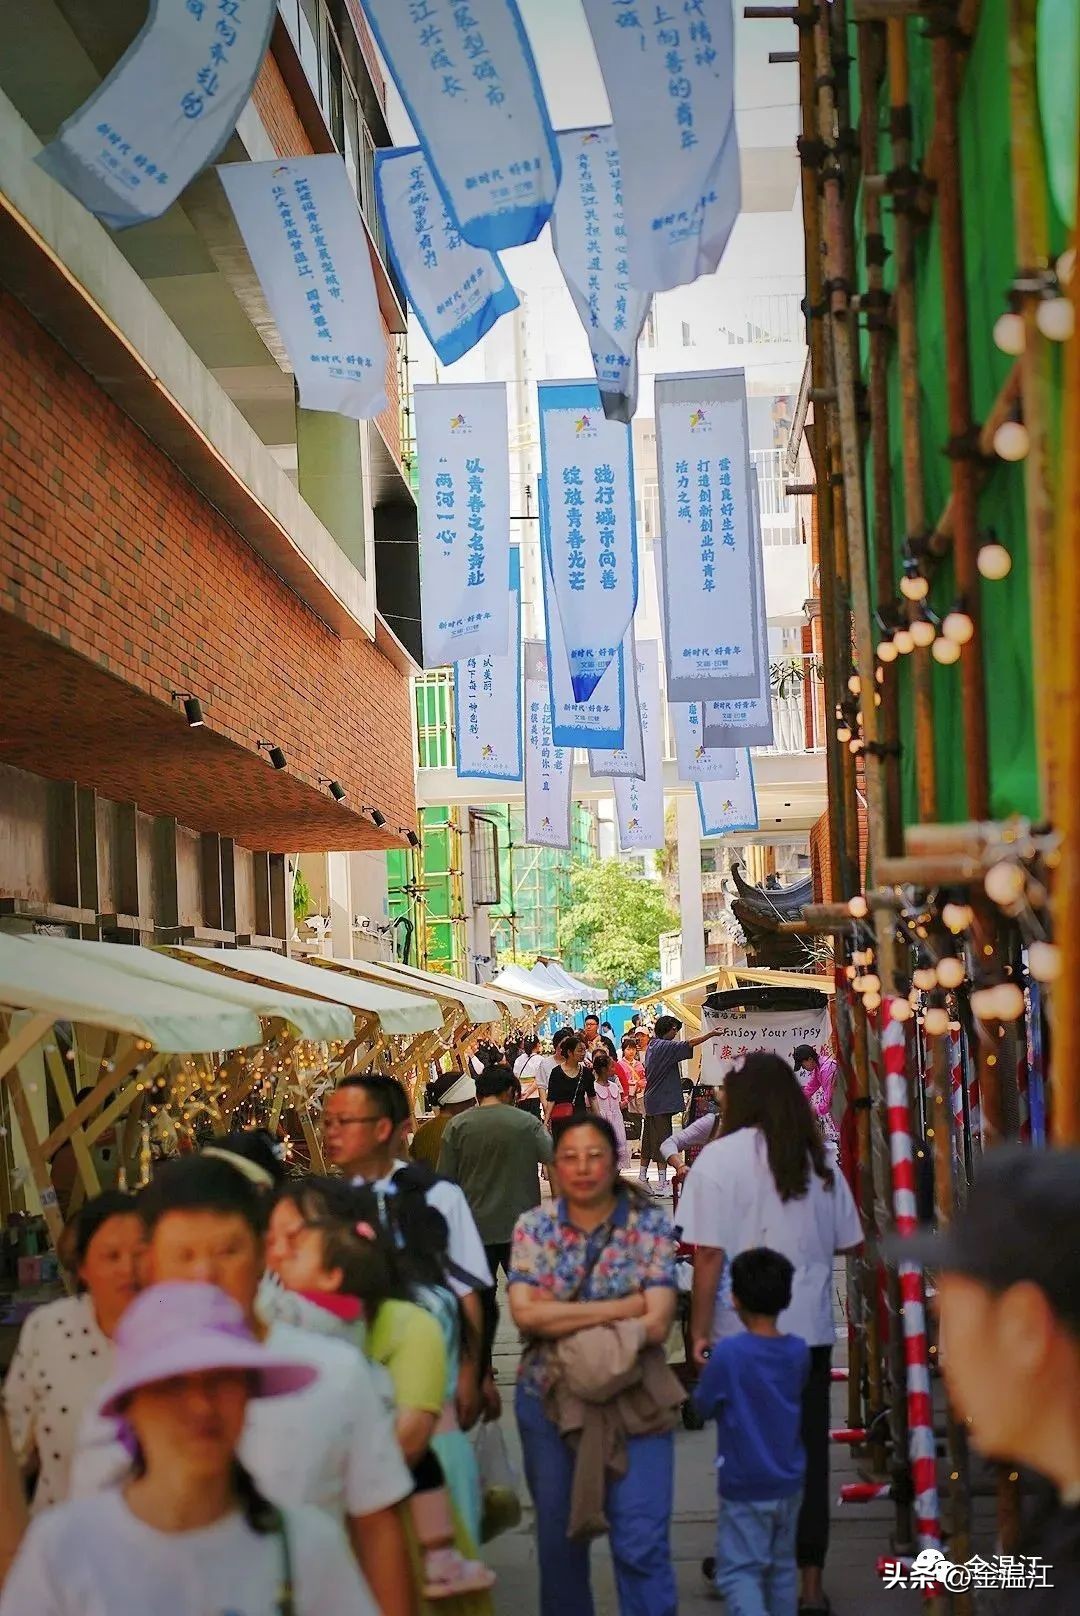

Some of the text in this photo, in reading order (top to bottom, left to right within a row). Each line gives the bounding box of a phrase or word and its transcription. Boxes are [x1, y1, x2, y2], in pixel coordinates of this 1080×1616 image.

[450, 0, 512, 119] 展型城市，
[465, 457, 486, 587] 以青春之名奔赴
[562, 465, 587, 592] 绽放青春光芒
[594, 463, 618, 591] 践行城市向善
[696, 459, 716, 593] 打造创新创业的青年
[718, 457, 736, 552] 营造良好生态，
[722, 1026, 821, 1040] Enjoy Your Tipsy
